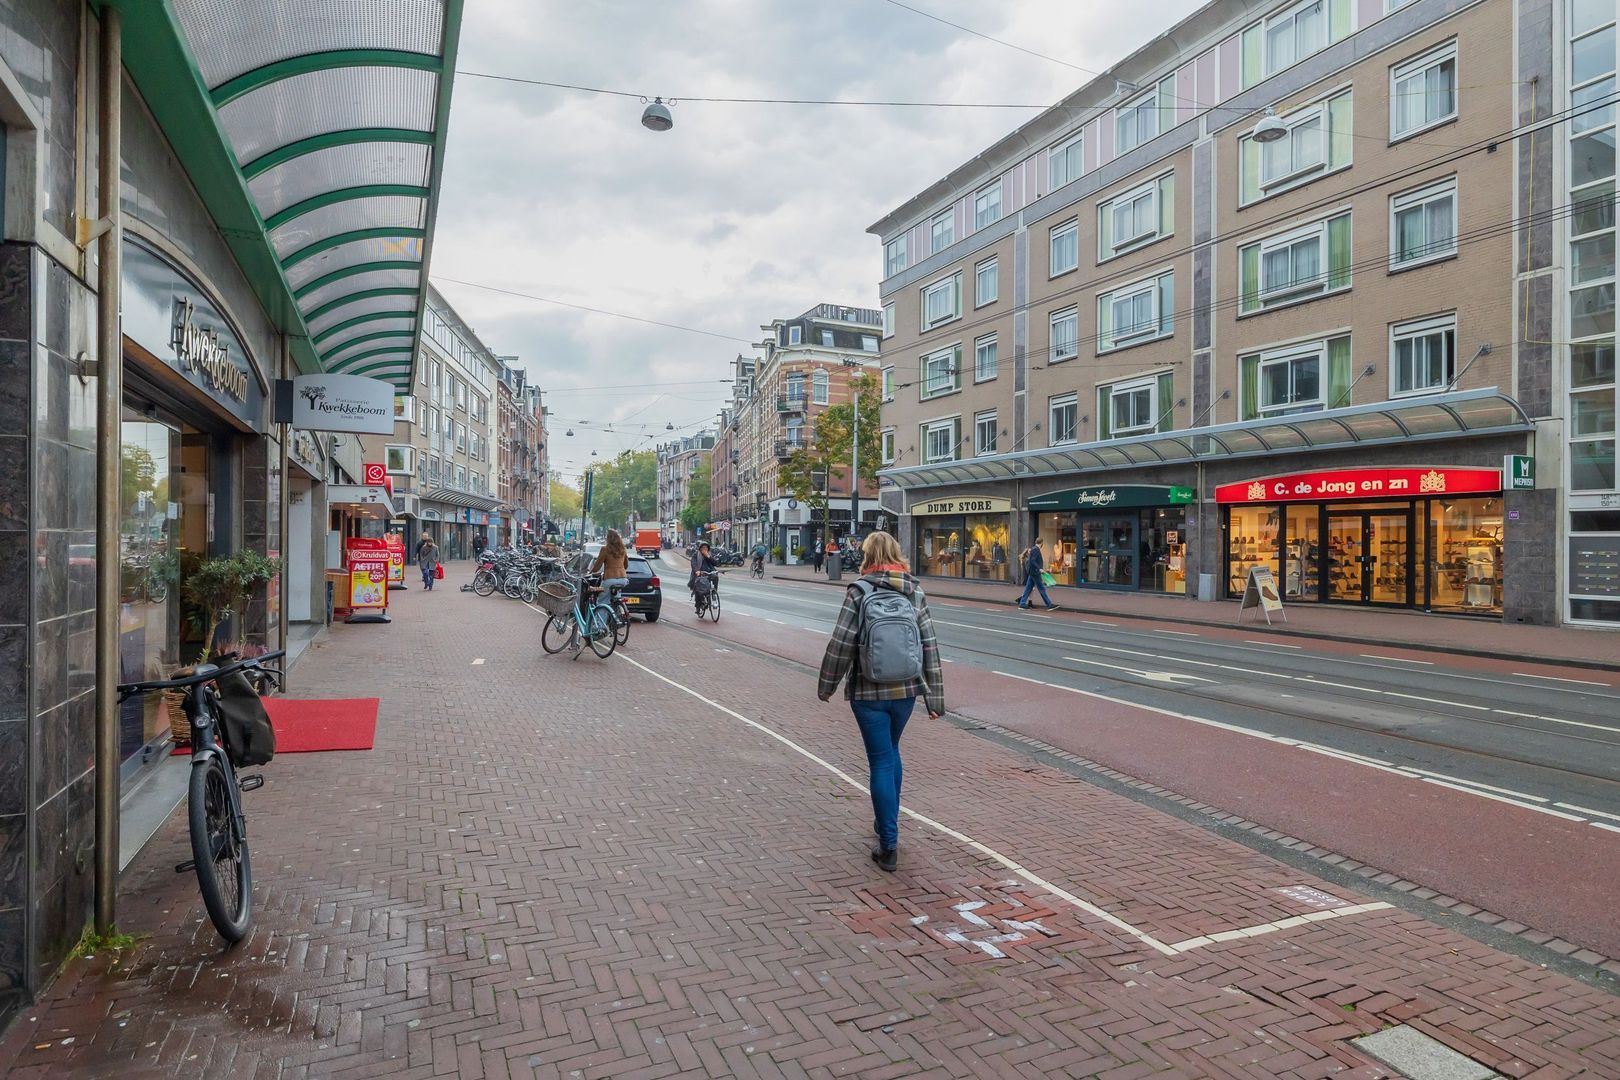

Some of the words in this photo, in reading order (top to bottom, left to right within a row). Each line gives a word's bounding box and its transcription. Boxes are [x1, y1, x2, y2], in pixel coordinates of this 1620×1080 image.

[181, 297, 249, 403] Kwekkeboom
[318, 401, 386, 415] Kwekkeboom
[1274, 483, 1289, 495] C.
[1294, 481, 1312, 494] de
[1317, 480, 1356, 494] Jong
[1361, 479, 1383, 490] en
[1388, 478, 1409, 489] zn
[927, 503, 954, 513] DUMP
[958, 500, 992, 512] STORE
